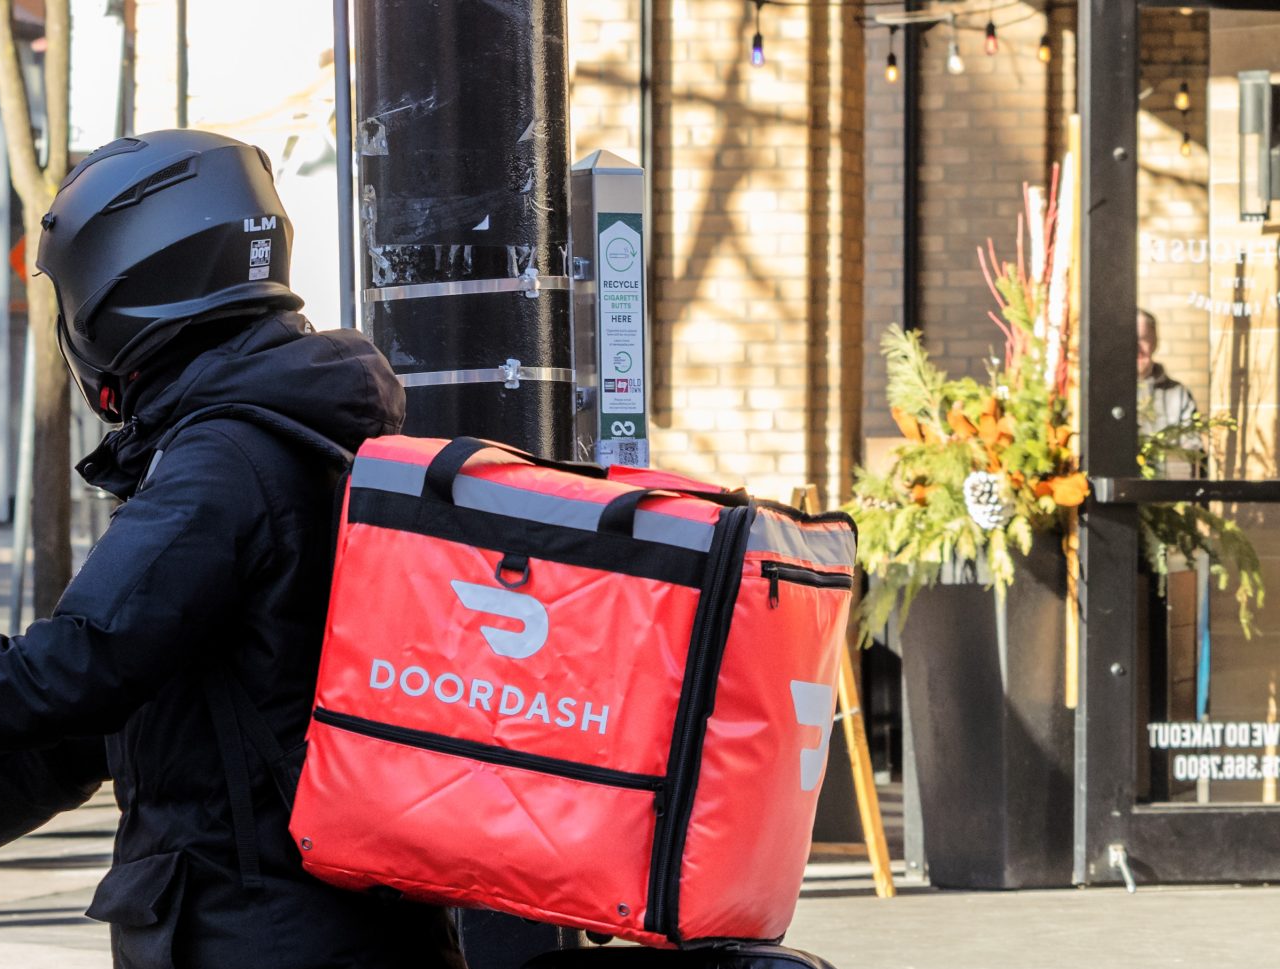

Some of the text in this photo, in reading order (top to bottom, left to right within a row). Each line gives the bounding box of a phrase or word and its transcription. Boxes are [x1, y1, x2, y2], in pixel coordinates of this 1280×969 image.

[243, 216, 277, 232] ILM
[252, 247, 270, 259] DOT
[603, 280, 639, 289] RECYCLE
[603, 294, 639, 302] CIGARETTE
[611, 302, 632, 310] BUTTS
[611, 315, 632, 323] HERE
[628, 378, 642, 387] OLD
[370, 659, 609, 735] DOORDASH
